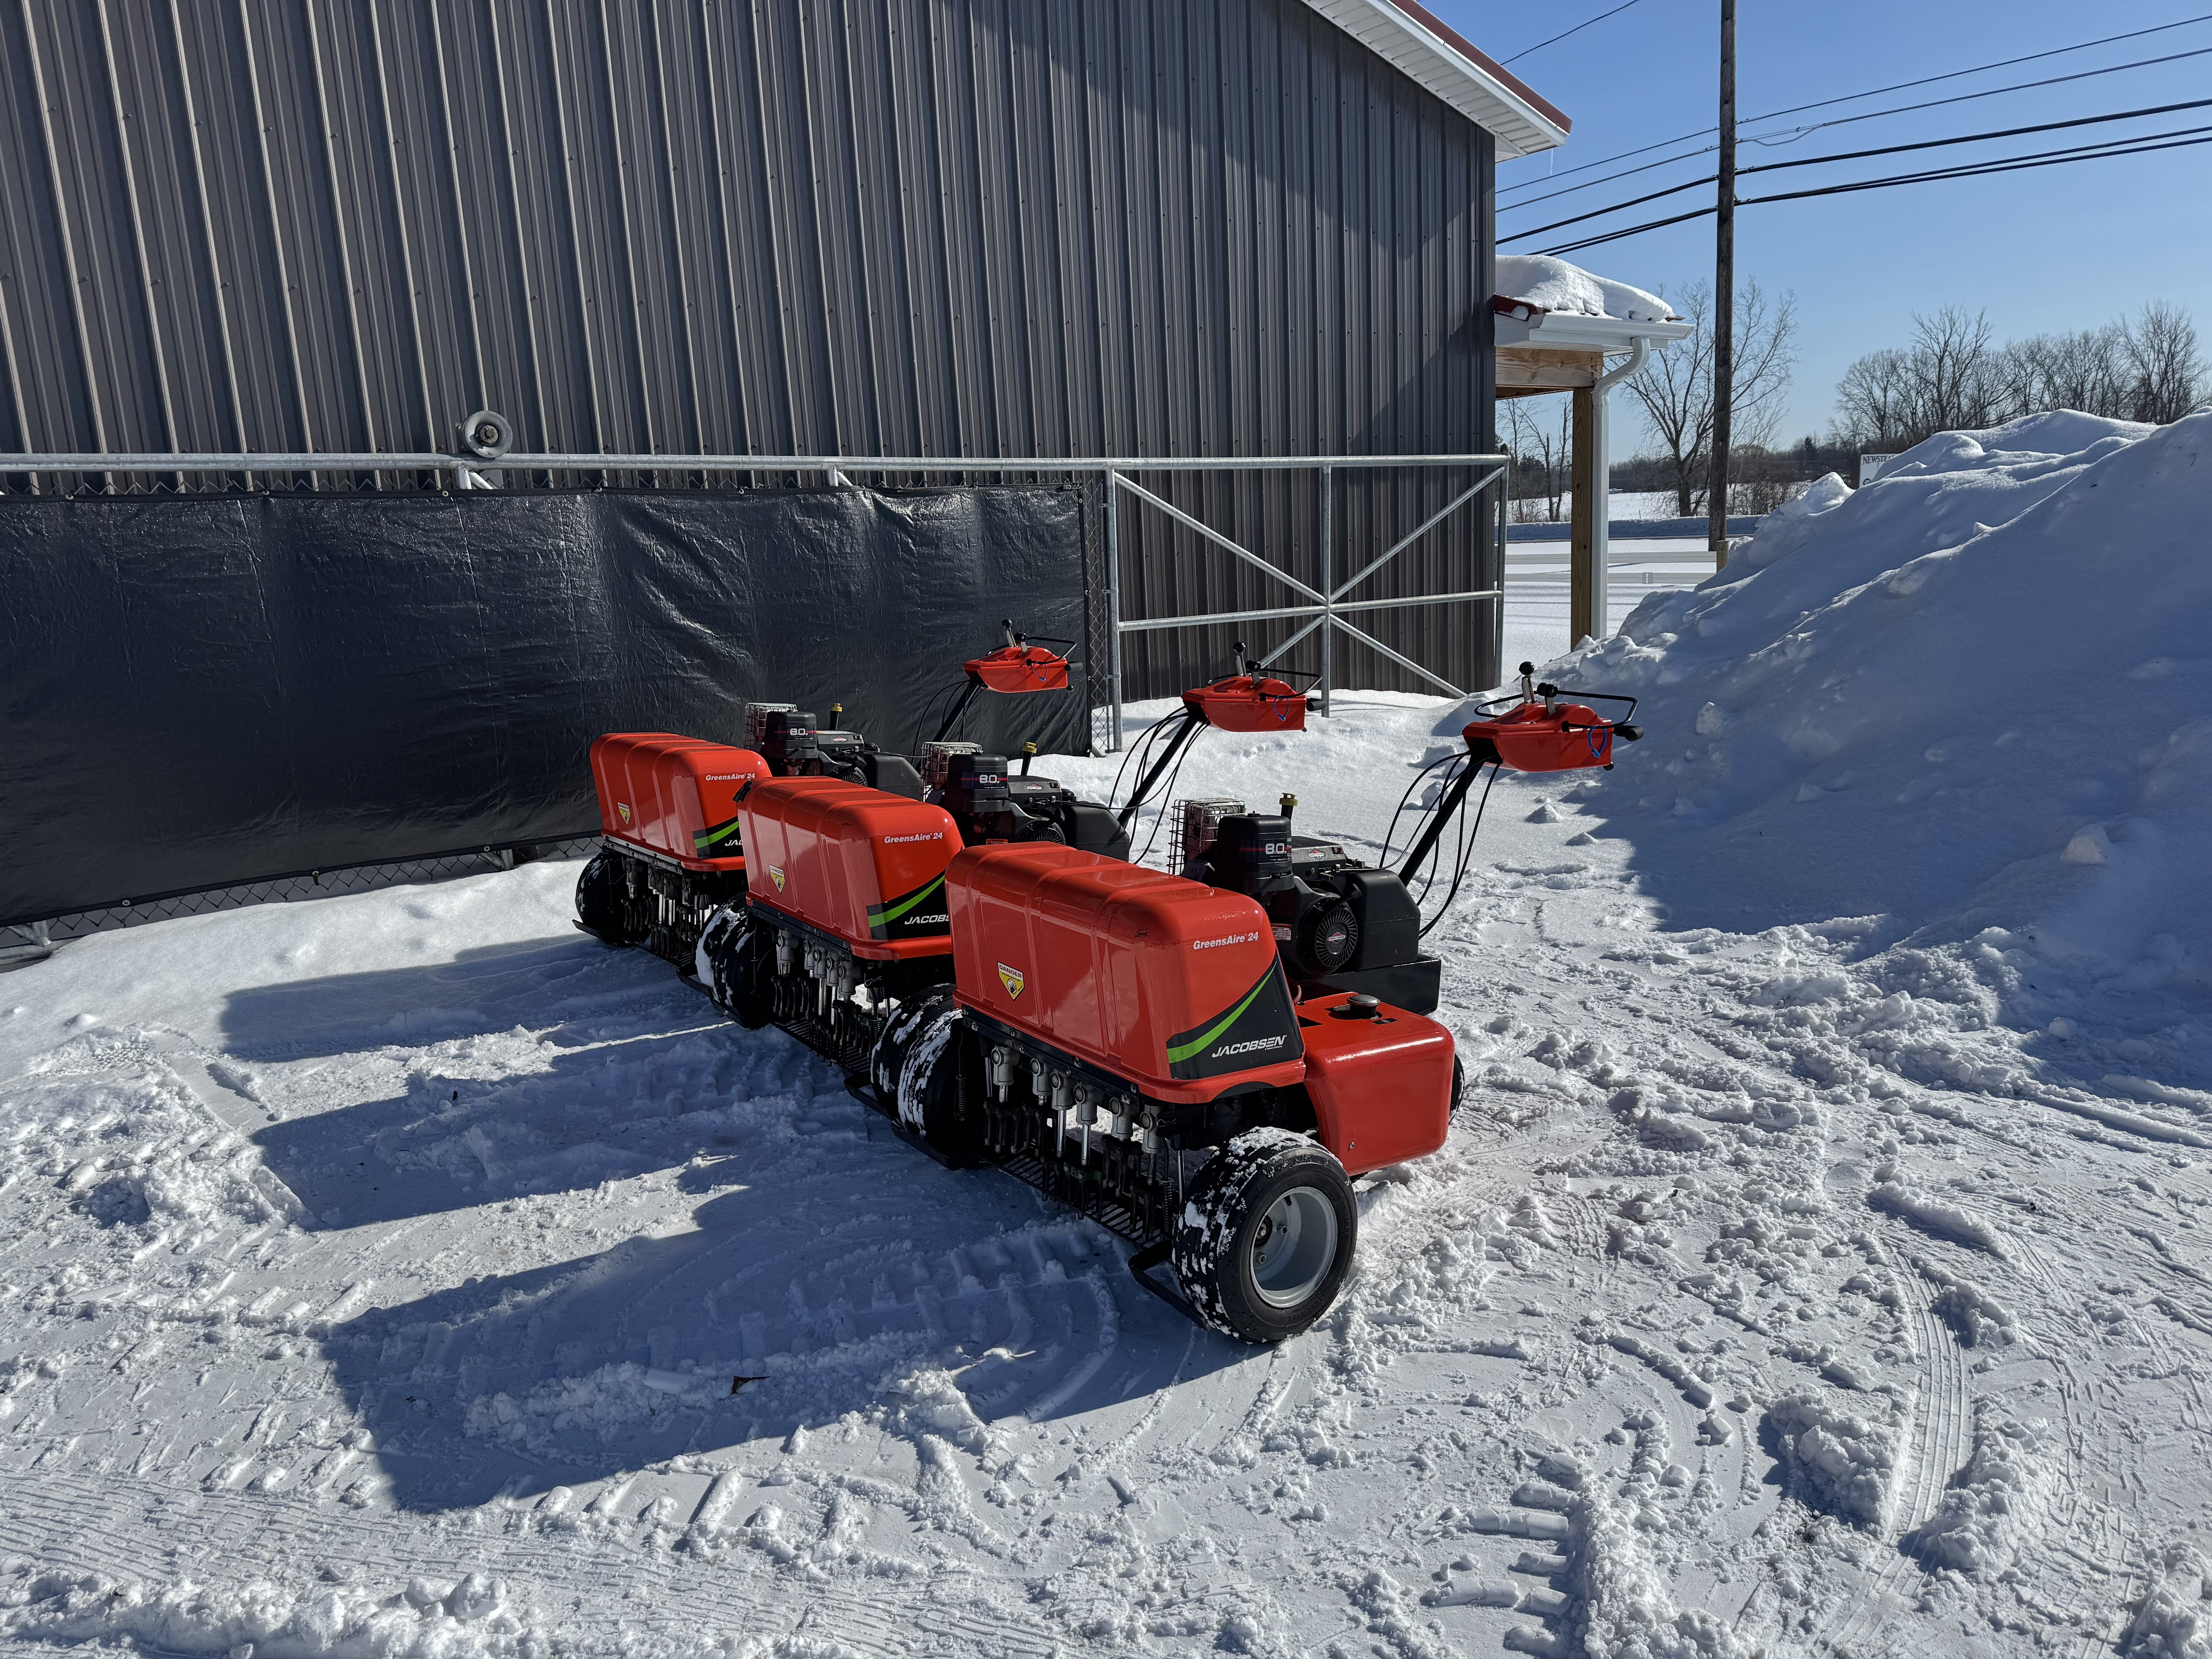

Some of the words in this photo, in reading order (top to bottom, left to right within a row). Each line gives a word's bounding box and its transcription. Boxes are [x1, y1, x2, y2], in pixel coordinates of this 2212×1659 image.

[1862, 455, 1896, 465] NEWSTE
[884, 833, 931, 843] GreensAire
[1193, 934, 1245, 950] GreensAire
[1247, 931, 1259, 941] 24
[999, 965, 1022, 978] DANGER
[1212, 1035, 1286, 1058] JACOBSEN
